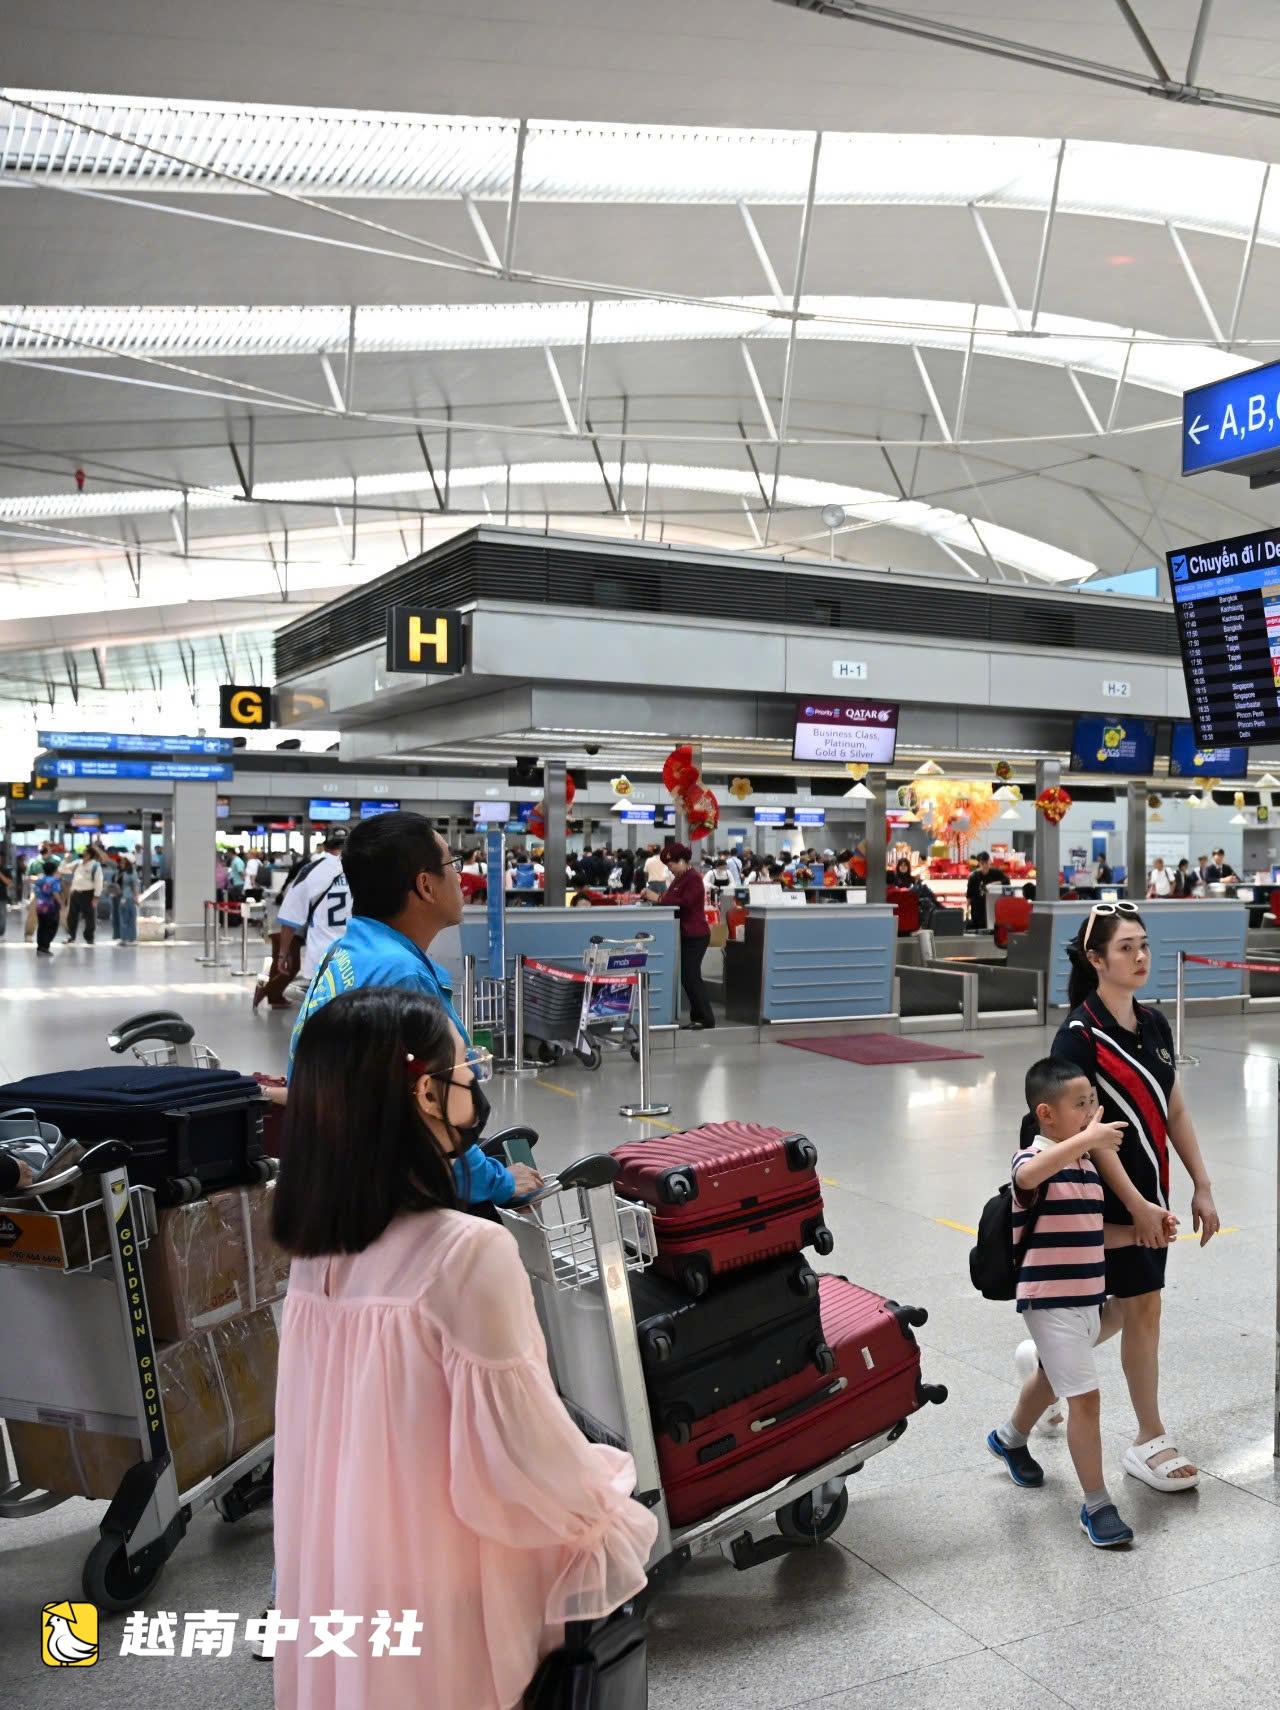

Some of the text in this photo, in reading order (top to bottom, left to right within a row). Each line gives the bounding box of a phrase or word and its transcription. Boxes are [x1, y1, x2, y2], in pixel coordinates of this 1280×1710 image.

[1189, 545, 1238, 574] Chuyến
[1242, 546, 1254, 565] đi
[1257, 547, 1262, 562] /
[408, 615, 448, 663] H
[840, 664, 861, 677] H-1
[1108, 683, 1127, 696] H-2
[229, 690, 263, 725] G
[846, 708, 878, 719] QATAR
[813, 728, 853, 738] Business
[815, 747, 874, 759] Gold & Silver
[12, 783, 25, 798] E
[120, 1228, 160, 1431] GOLDSUN GROUP
